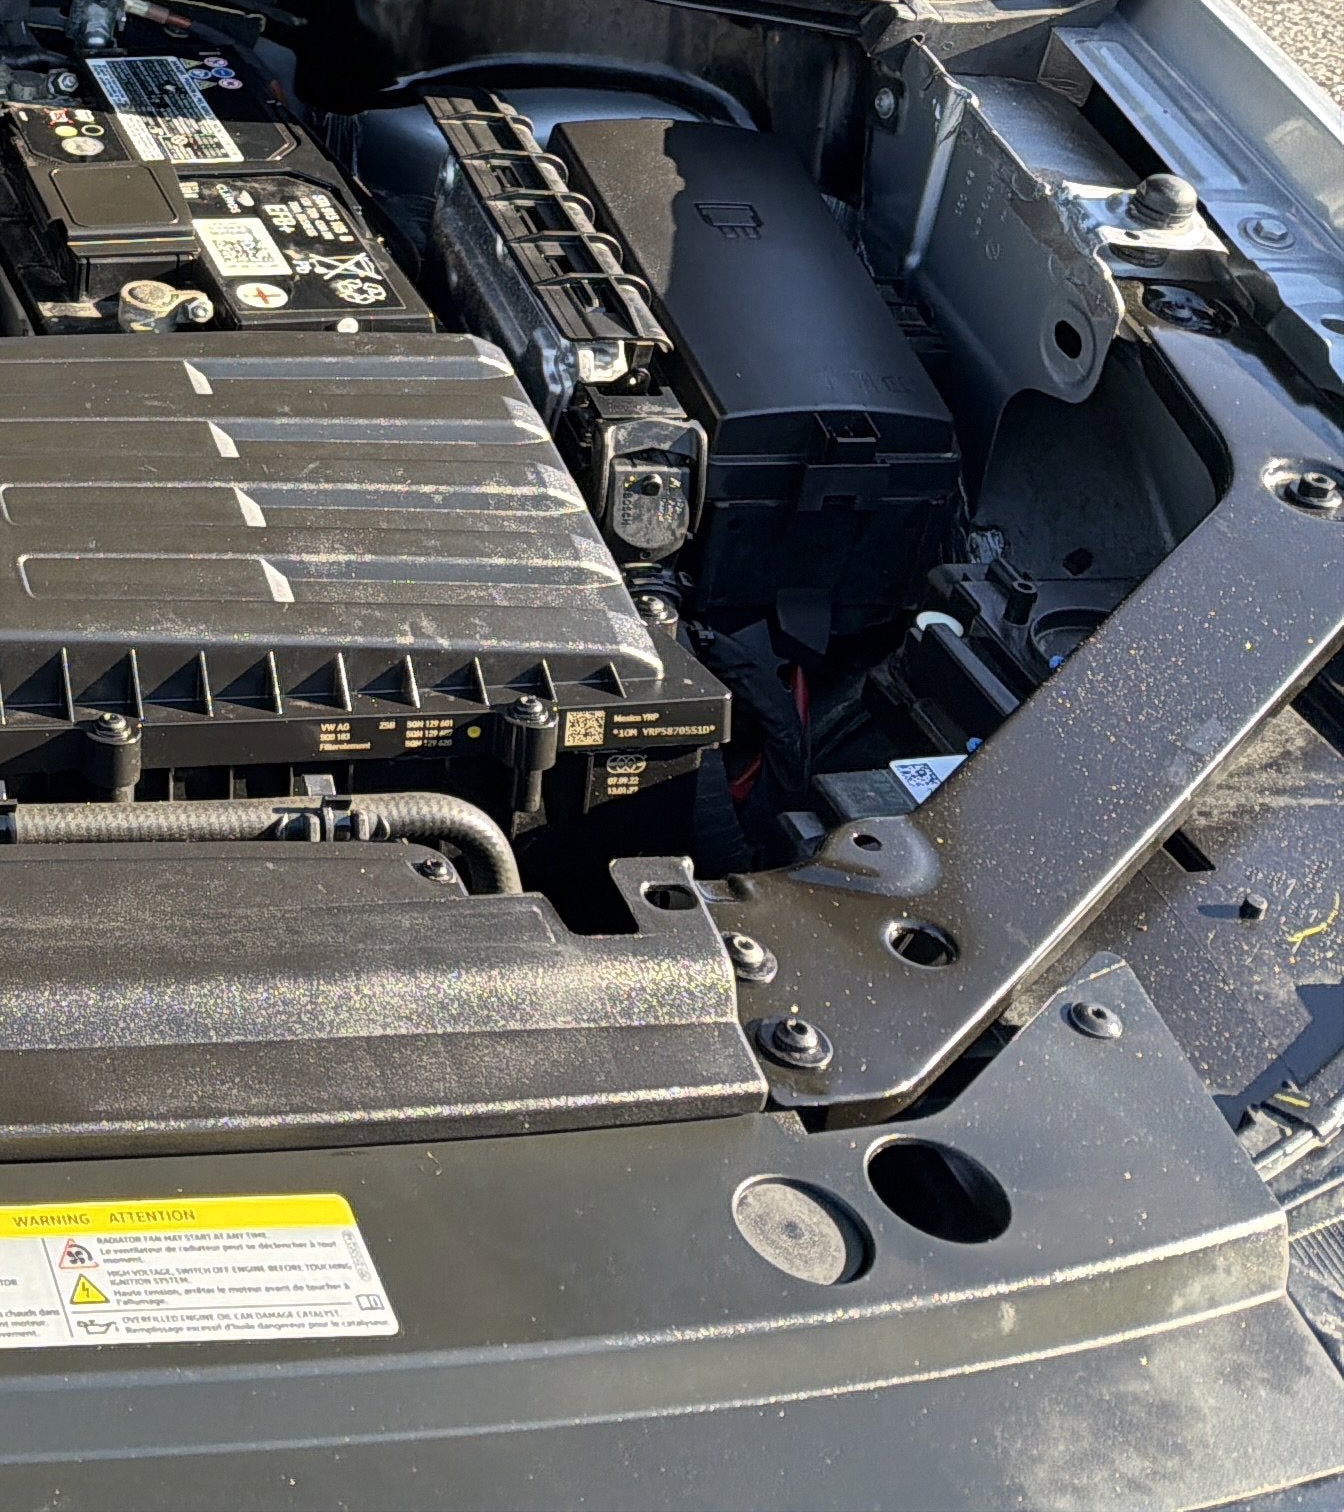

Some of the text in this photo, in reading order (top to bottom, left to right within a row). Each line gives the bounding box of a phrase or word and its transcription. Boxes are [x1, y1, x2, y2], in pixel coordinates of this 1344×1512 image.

[642, 713, 660, 722] YRP
[321, 723, 350, 731] VW AG
[13, 1210, 196, 1228] WARNING ATTENTION
[96, 1236, 141, 1244] RADIATOR
[143, 1235, 162, 1243] FAN
[164, 1234, 183, 1242] MAY
[184, 1233, 211, 1241] START
[214, 1232, 224, 1240] AT
[227, 1232, 244, 1240] ANY
[176, 1267, 211, 1275] SWITCH
[232, 1265, 266, 1273] ENGINE
[268, 1263, 302, 1272] BEFORE
[305, 1262, 353, 1271] TOUCHING
[110, 1278, 151, 1286] IGNITION
[113, 1289, 142, 1297] Haute
[293, 1283, 304, 1291] de
[5, 1310, 37, 1318] chauds
[39, 1309, 60, 1317] dans
[181, 1314, 214, 1322] ENGINE
[216, 1313, 232, 1321] OIL
[234, 1311, 254, 1320] CAN
[256, 1310, 293, 1319] DAMAGE
